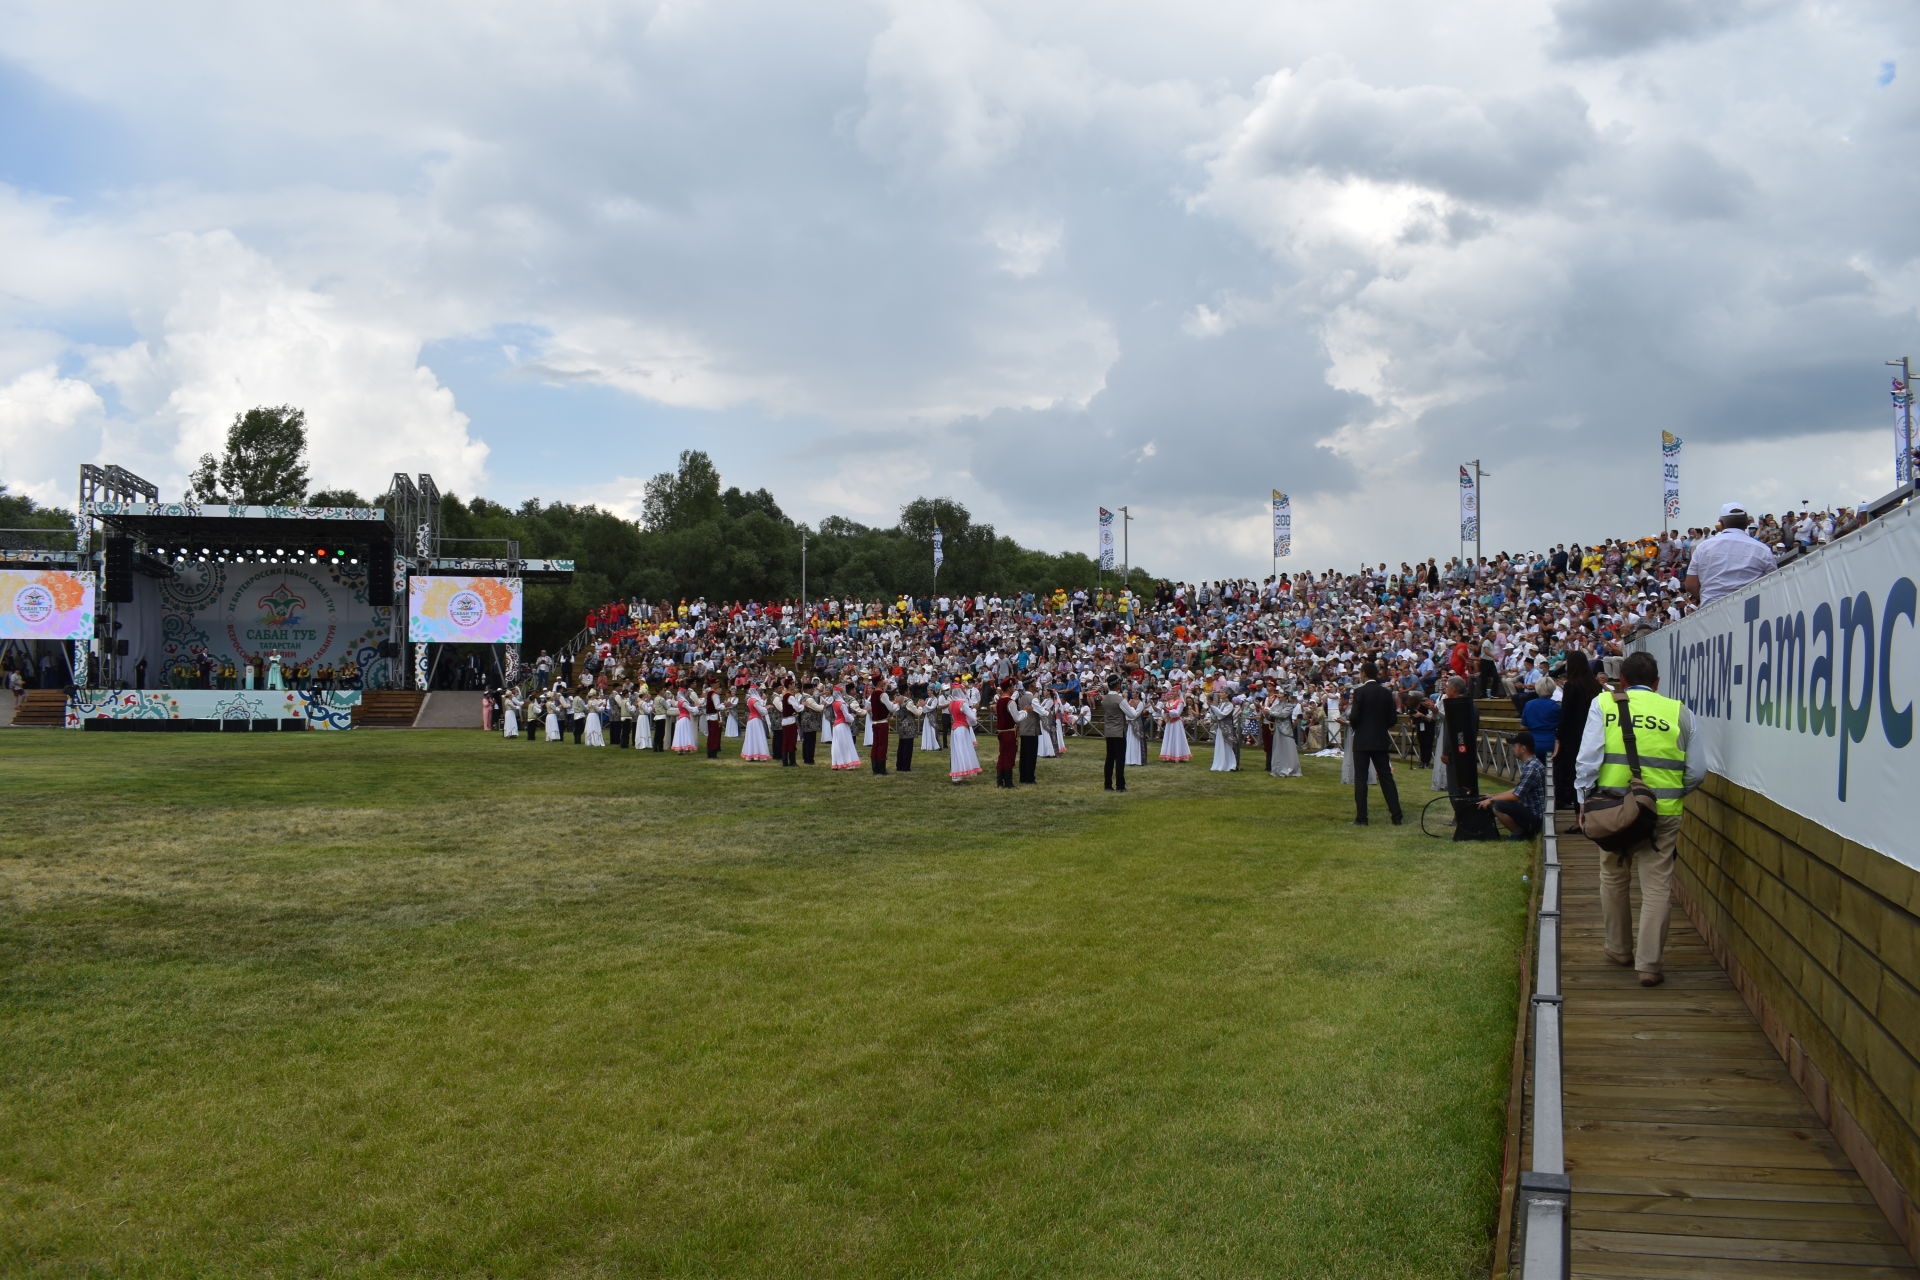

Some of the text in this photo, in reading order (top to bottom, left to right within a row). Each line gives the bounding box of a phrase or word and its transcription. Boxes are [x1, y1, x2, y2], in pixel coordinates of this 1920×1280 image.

[247, 629, 317, 641] САБАН ТУЕ
[1605, 713, 1671, 732] PESS
